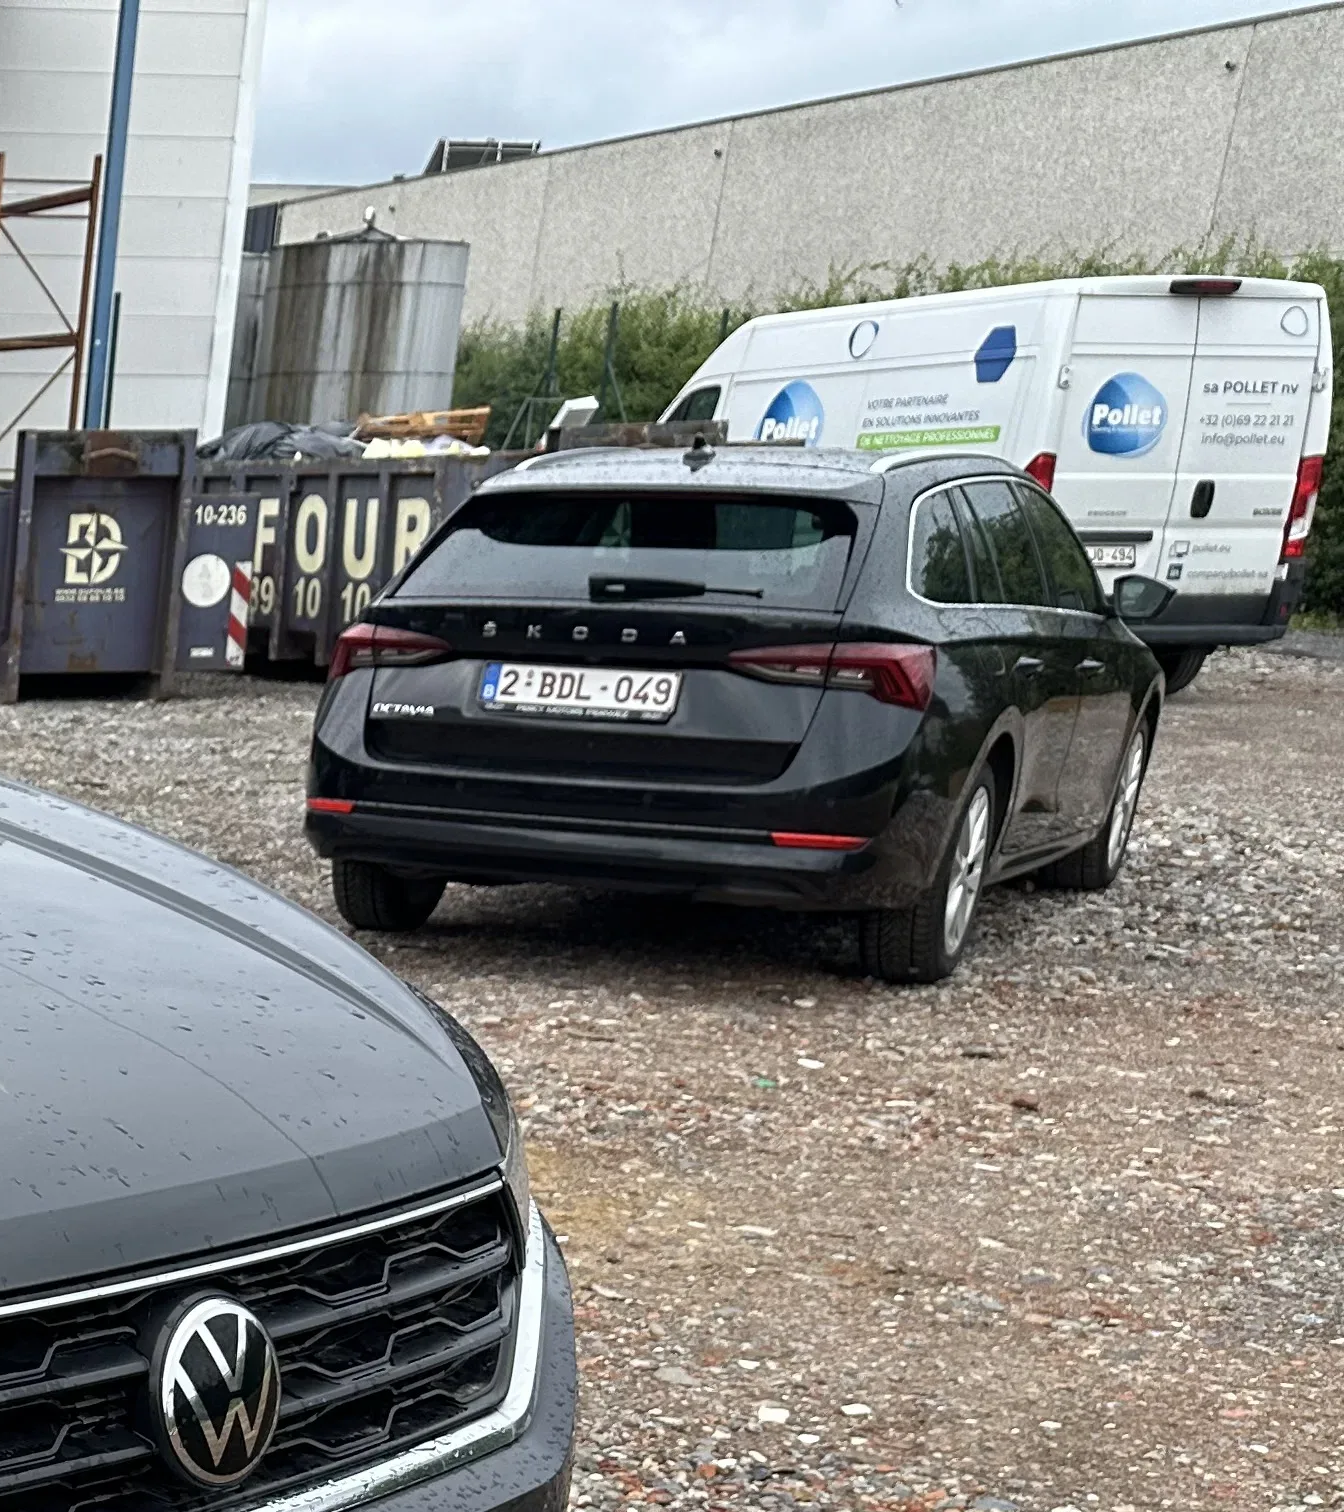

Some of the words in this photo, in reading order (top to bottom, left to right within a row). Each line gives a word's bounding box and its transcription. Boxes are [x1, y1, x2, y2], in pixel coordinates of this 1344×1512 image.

[1203, 382, 1218, 394] sa
[1223, 381, 1278, 394] POLLET
[1282, 383, 1299, 394] nv
[1092, 404, 1161, 425] Pollet
[1199, 415, 1218, 426] +32
[1221, 414, 1250, 427] (0)69
[1255, 415, 1267, 426] 22
[761, 416, 818, 441] Pollet
[1201, 433, 1285, 446] info@pollet.eu
[195, 504, 247, 526] 10-236
[294, 576, 321, 619] 10
[500, 669, 672, 706] 2-BDL-049
